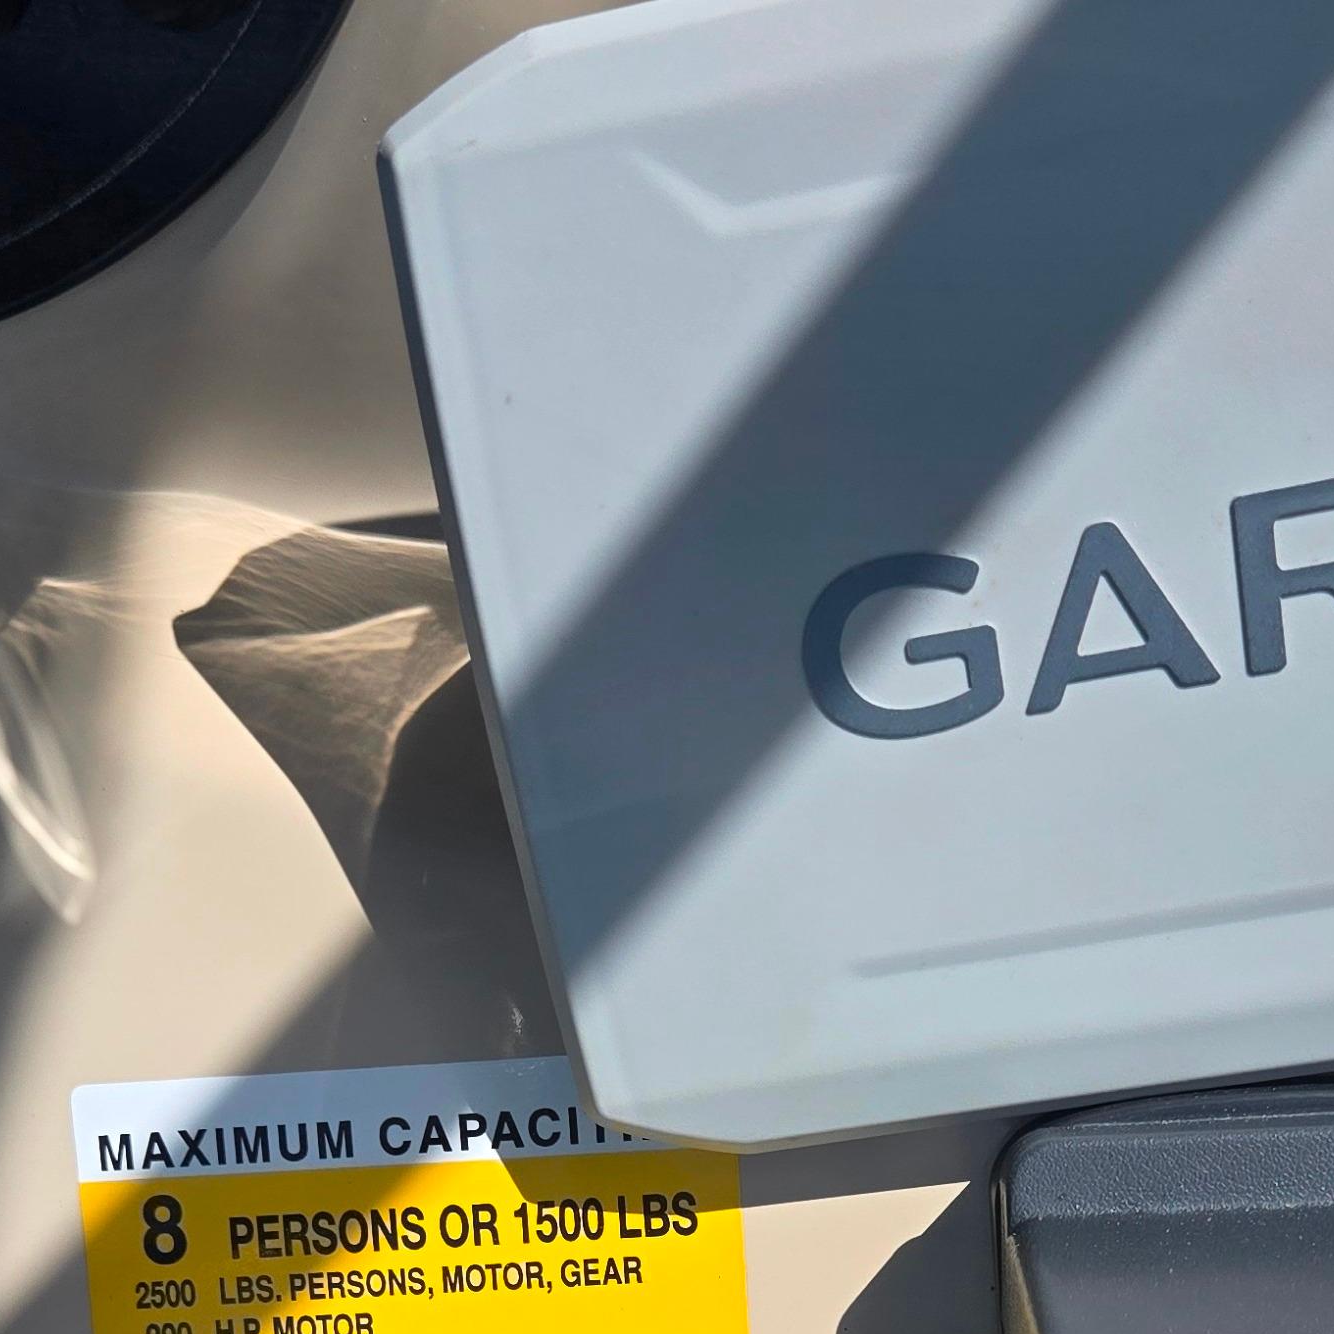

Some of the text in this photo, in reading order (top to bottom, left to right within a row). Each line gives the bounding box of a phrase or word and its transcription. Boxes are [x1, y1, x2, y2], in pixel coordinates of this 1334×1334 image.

[98, 1106, 650, 1171] MAXIMUM CAPACI
[143, 1191, 698, 1265] 8 PERSONS OR 1500 LBS
[135, 1256, 642, 1309] 2500 LBS. PERSONS, MOTOR, GEAR
